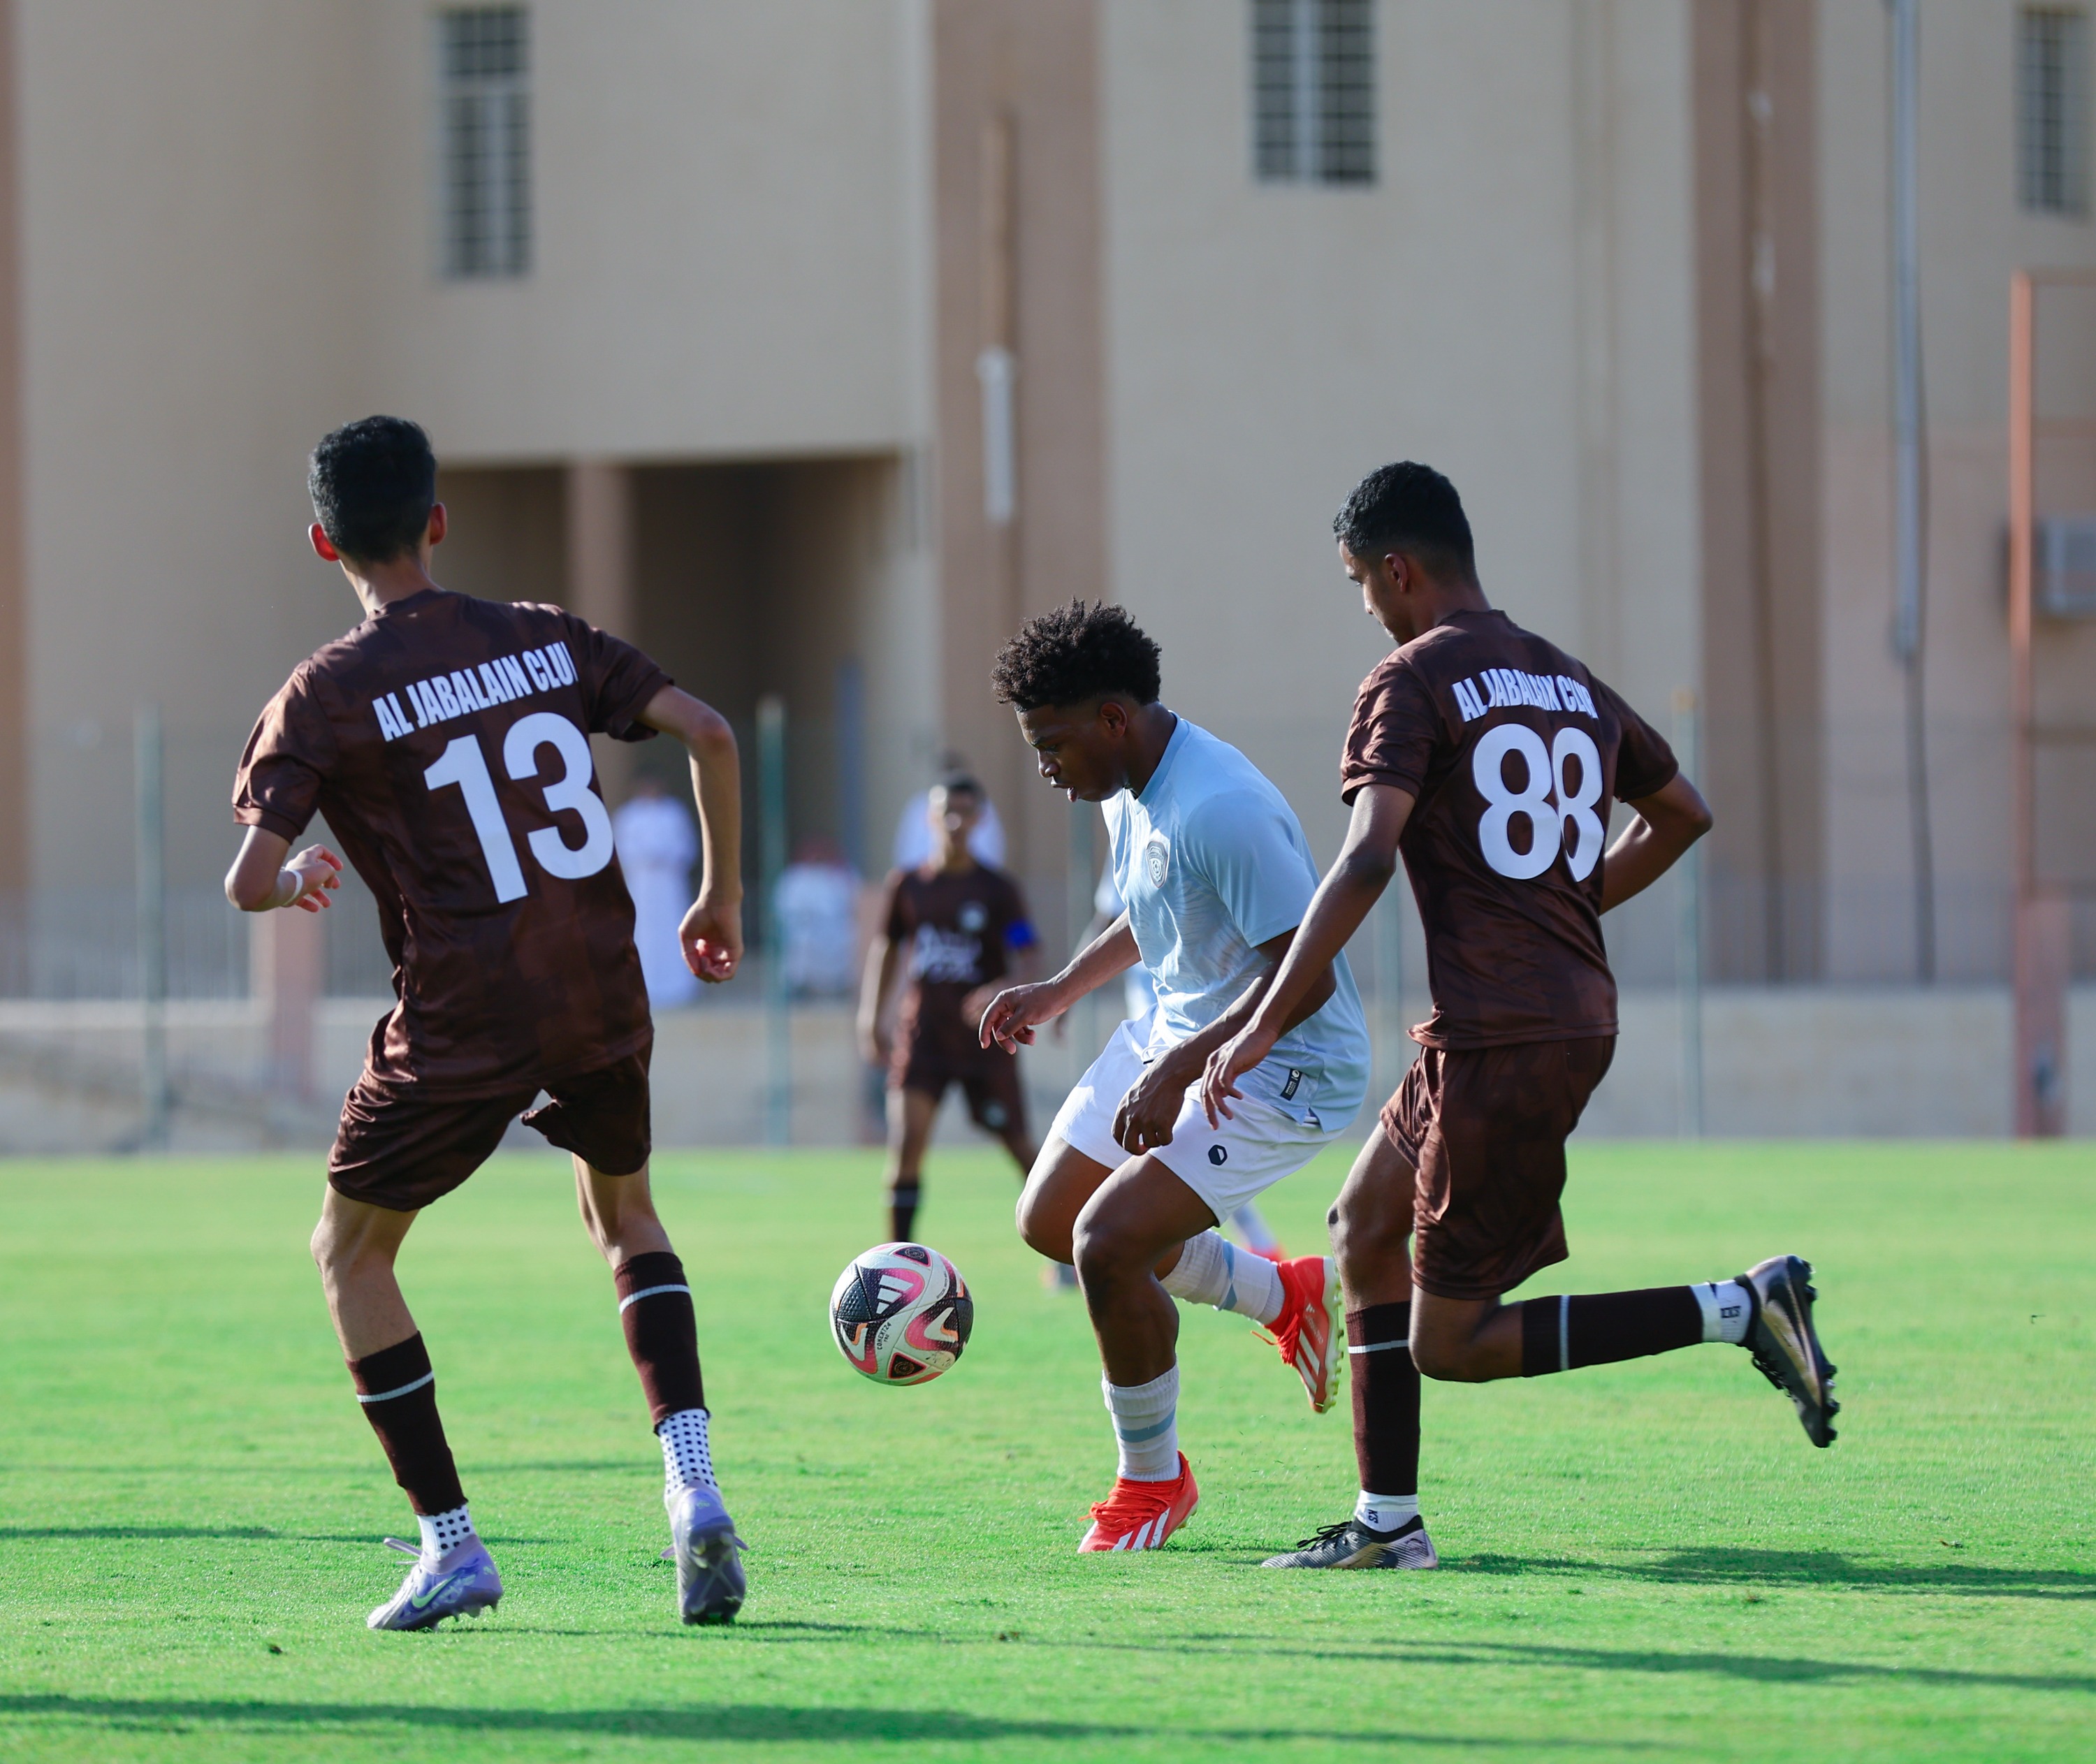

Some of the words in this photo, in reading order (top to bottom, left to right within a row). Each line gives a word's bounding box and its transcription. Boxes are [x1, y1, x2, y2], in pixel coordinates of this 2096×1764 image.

[372, 692, 415, 743] AL
[405, 655, 534, 729] JABALAIN
[1452, 677, 1489, 722] AL
[423, 712, 615, 904] 13
[1472, 723, 1605, 883] 88
